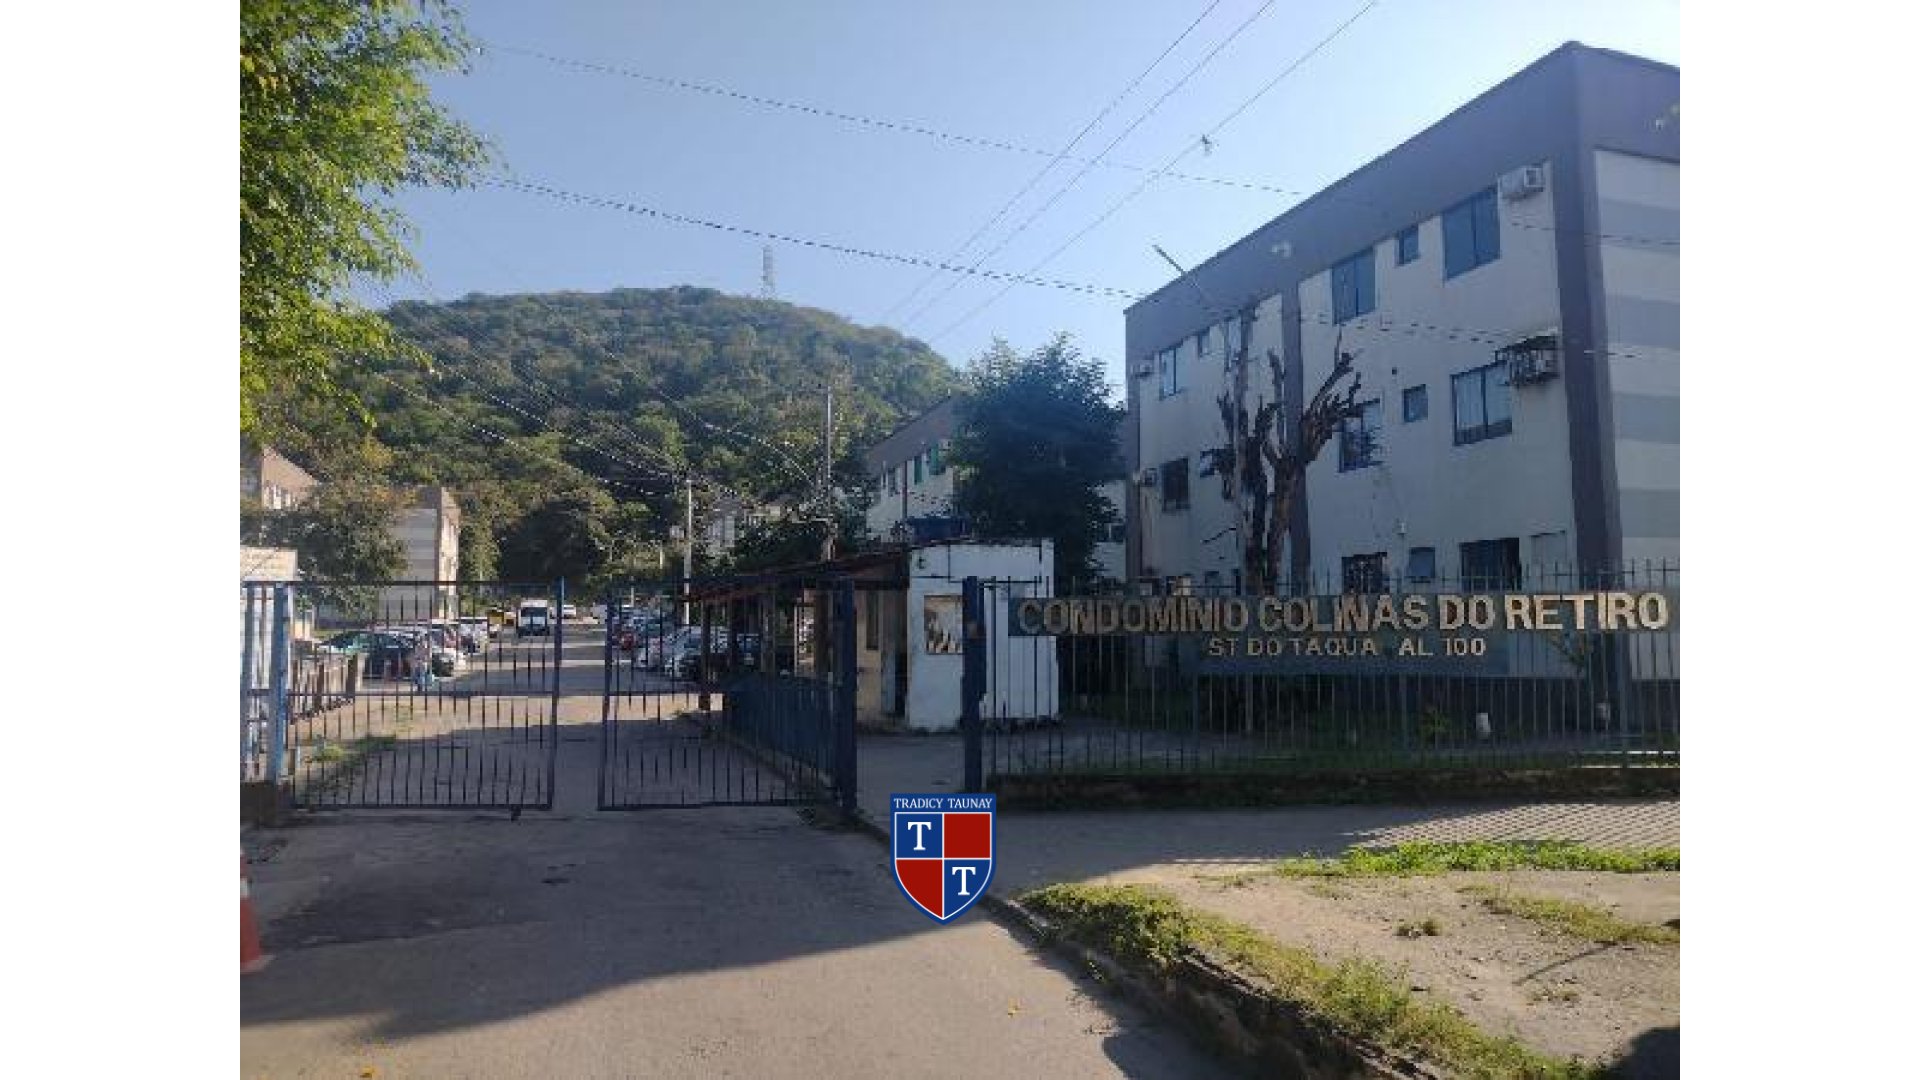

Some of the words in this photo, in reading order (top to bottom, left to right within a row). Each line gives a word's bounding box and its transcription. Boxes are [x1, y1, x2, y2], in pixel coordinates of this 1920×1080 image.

[1258, 594, 1430, 633] COLINAS
[1438, 594, 1496, 631] DO
[1505, 592, 1669, 631] RETIRO
[1248, 639, 1282, 656] DO
[1398, 638, 1434, 656] AL
[1445, 638, 1487, 656] 100
